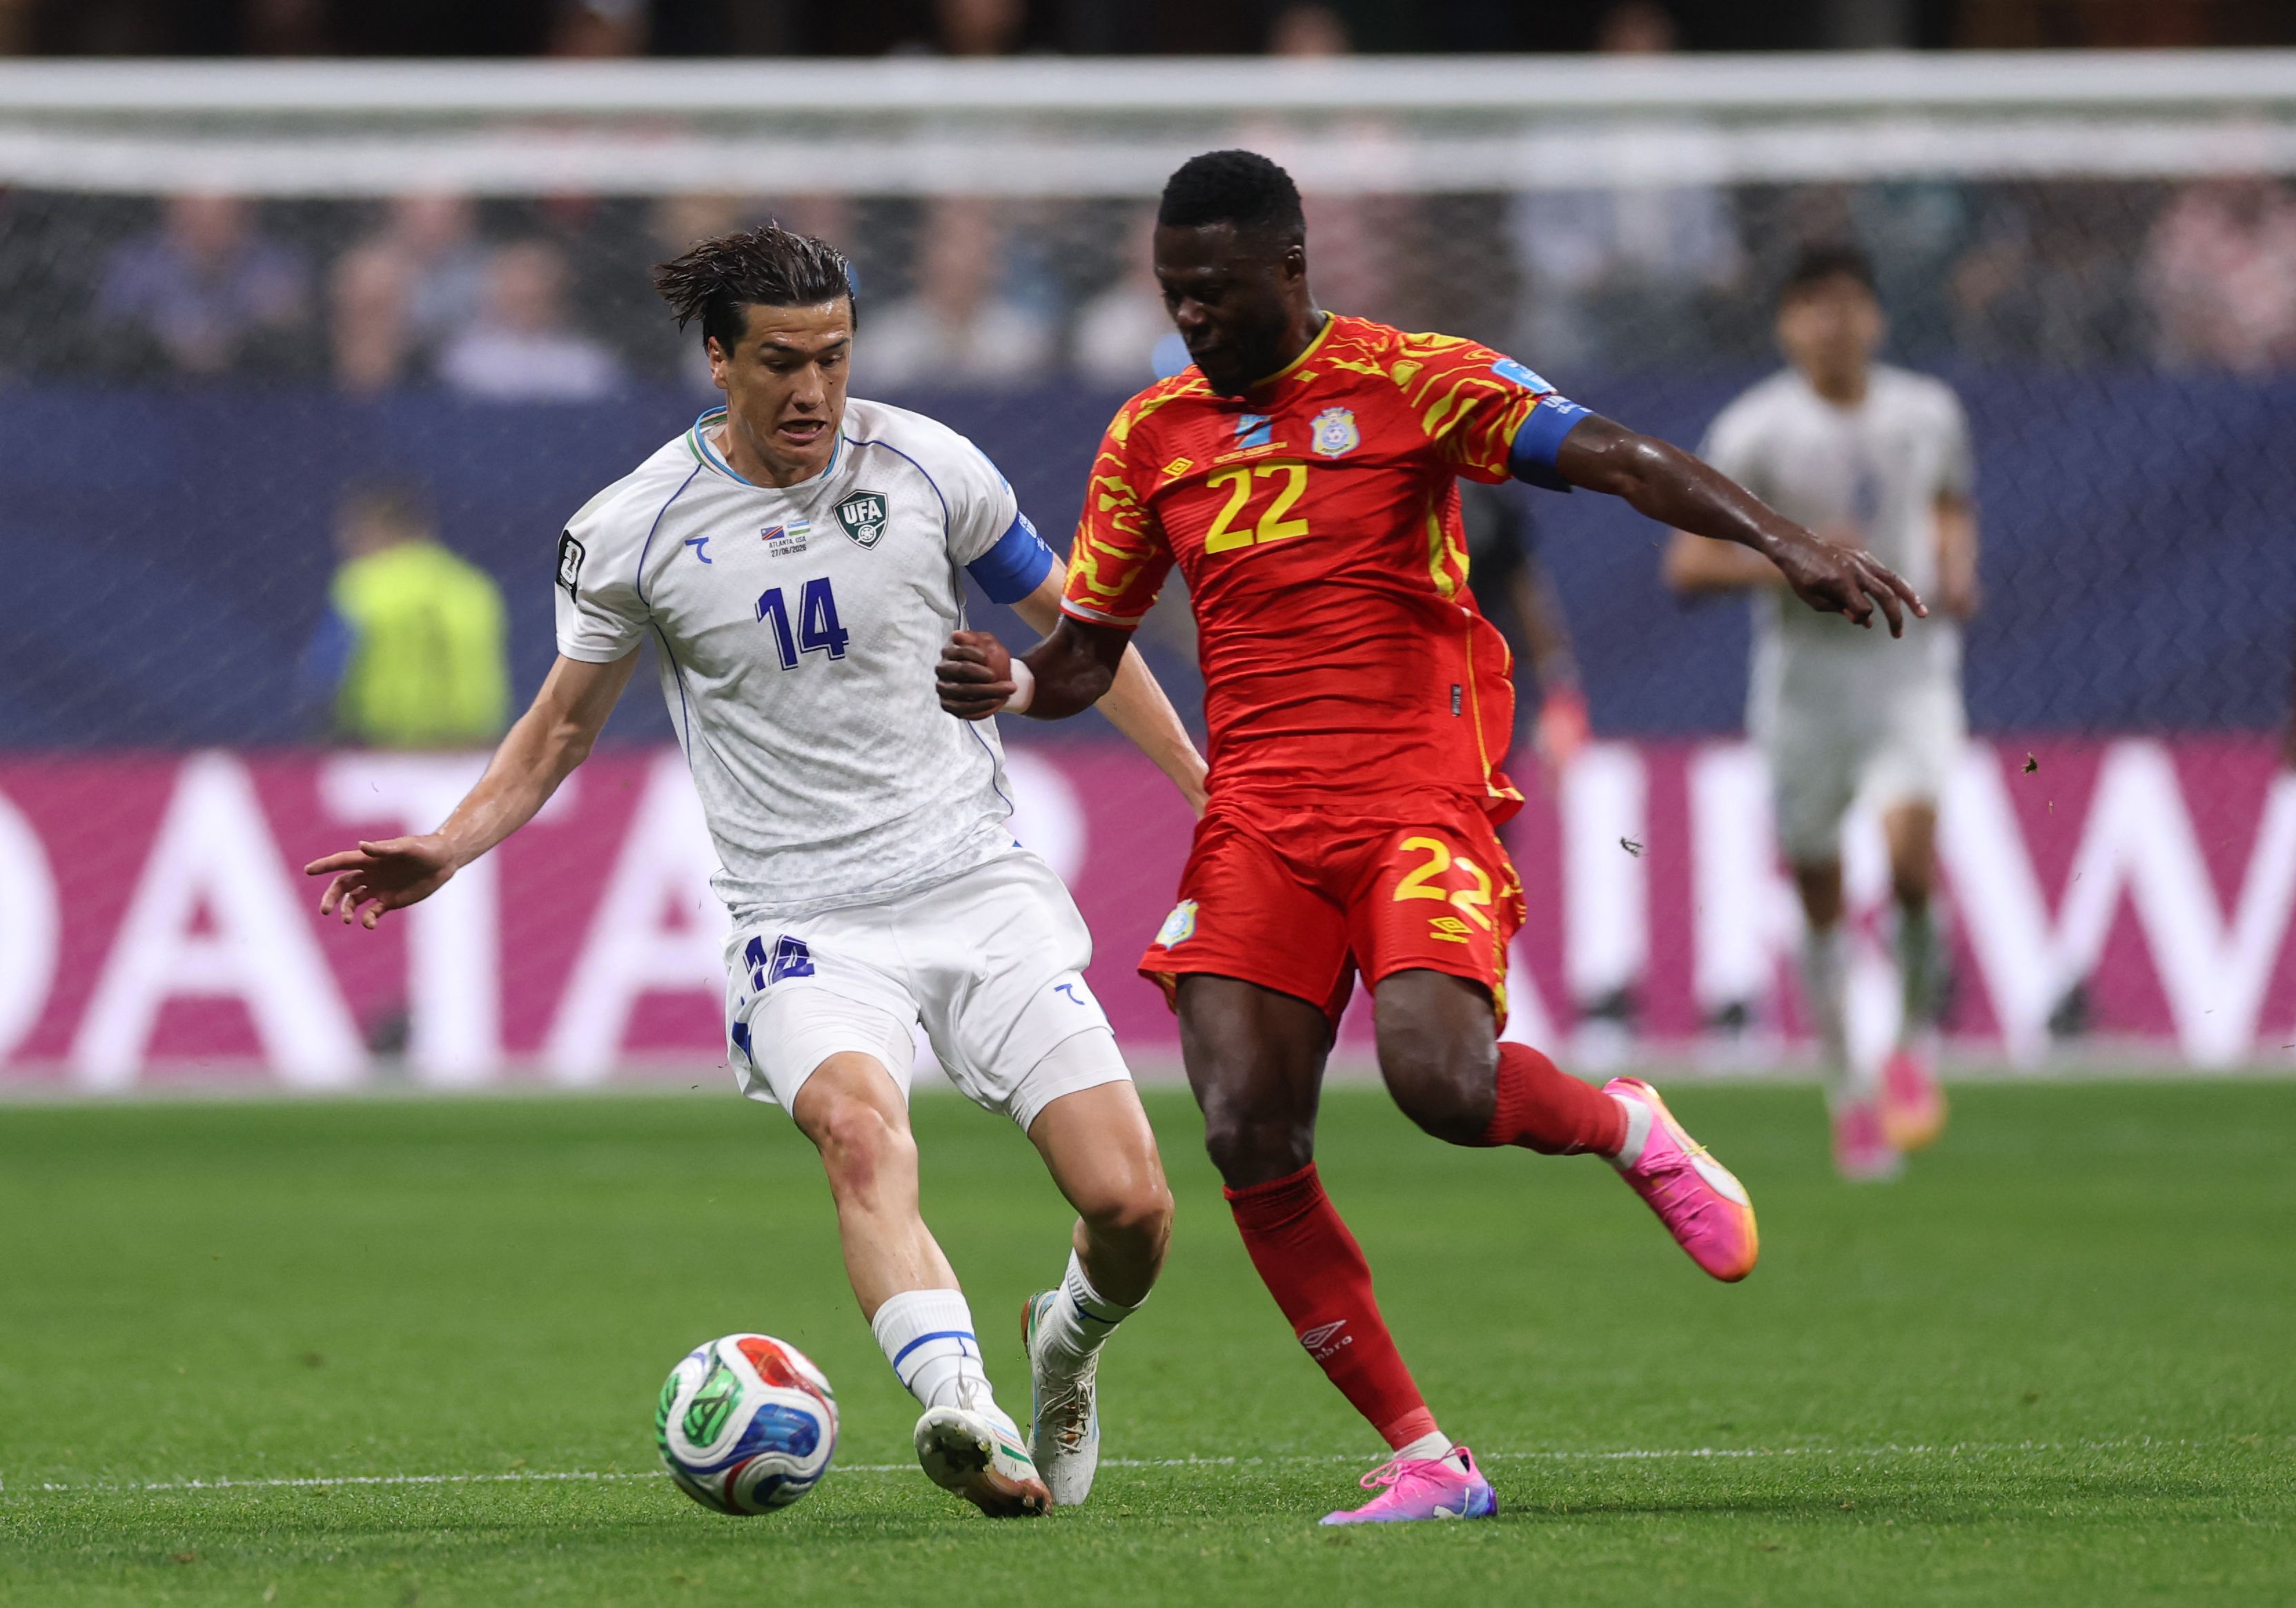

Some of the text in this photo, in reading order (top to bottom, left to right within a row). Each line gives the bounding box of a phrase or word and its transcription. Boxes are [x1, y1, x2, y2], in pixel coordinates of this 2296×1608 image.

[795, 535, 807, 545] USA
[842, 500, 883, 524] UFA
[1205, 458, 1309, 555] 22
[770, 544, 807, 558] 27/06/2026
[755, 577, 848, 670] 14
[0, 749, 1083, 1089] ATA
[1393, 836, 1492, 931] 22
[743, 934, 816, 994] 14
